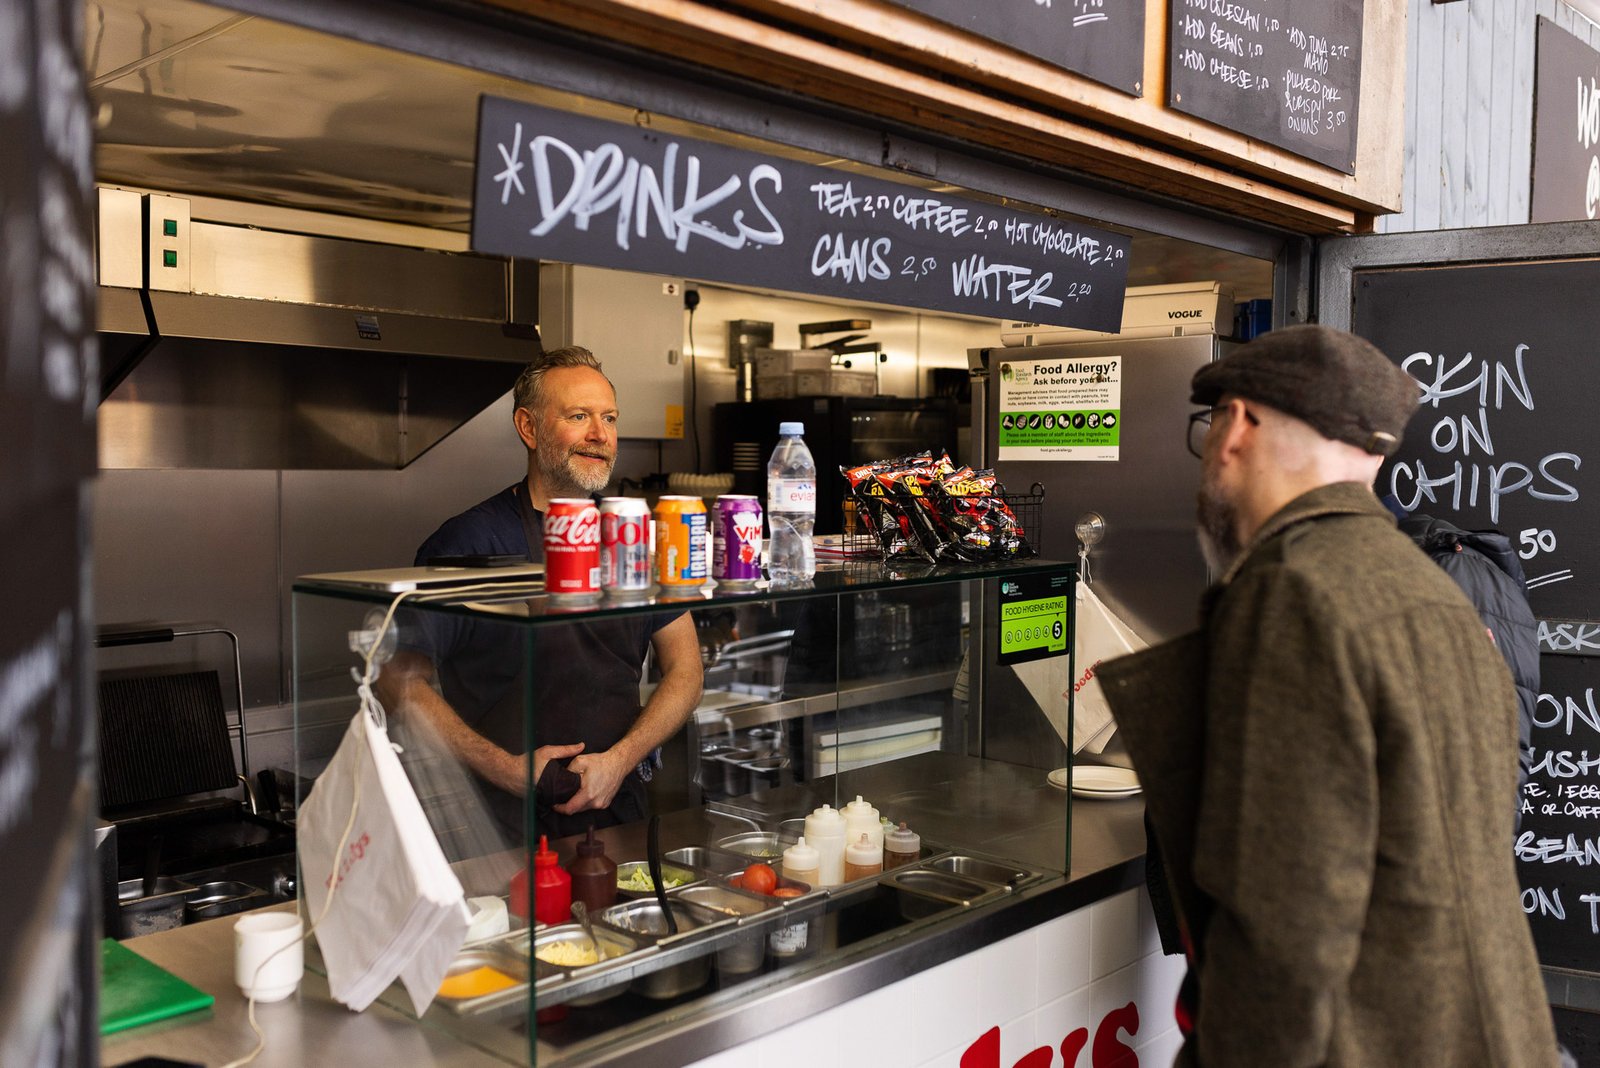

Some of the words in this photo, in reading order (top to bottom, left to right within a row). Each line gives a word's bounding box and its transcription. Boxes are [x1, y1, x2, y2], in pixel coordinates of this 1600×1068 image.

[1185, 14, 1205, 39] ADD
[1210, 22, 1243, 57] BEANS
[1289, 26, 1307, 50] ADD
[1184, 48, 1206, 72] ADD
[1210, 57, 1253, 89] CHEESE
[810, 180, 863, 218] TEA
[892, 194, 972, 237] COFFEE
[1005, 217, 1033, 246] HOT
[811, 232, 892, 284] CANS
[901, 255, 937, 282] 2,50
[952, 254, 1063, 310] WATER
[1067, 282, 1092, 302] 2,20
[1167, 309, 1203, 320] VOGUE
[1034, 364, 1062, 375] Food
[1066, 361, 1117, 375] Allergy?
[1051, 377, 1077, 385] before
[1401, 343, 1534, 411] SKIN
[1431, 407, 1494, 456] ON
[1391, 452, 1581, 524] CHIPS
[736, 525, 762, 541] ViM
[1519, 528, 1557, 559] 50
[1005, 606, 1022, 616] FOOD
[1022, 603, 1045, 614] HYGIENE
[1045, 600, 1064, 611] RATING
[1054, 622, 1061, 638] 5
[1537, 620, 1600, 651] ASK
[1541, 803, 1563, 816] OR
[1520, 886, 1566, 921] ON
